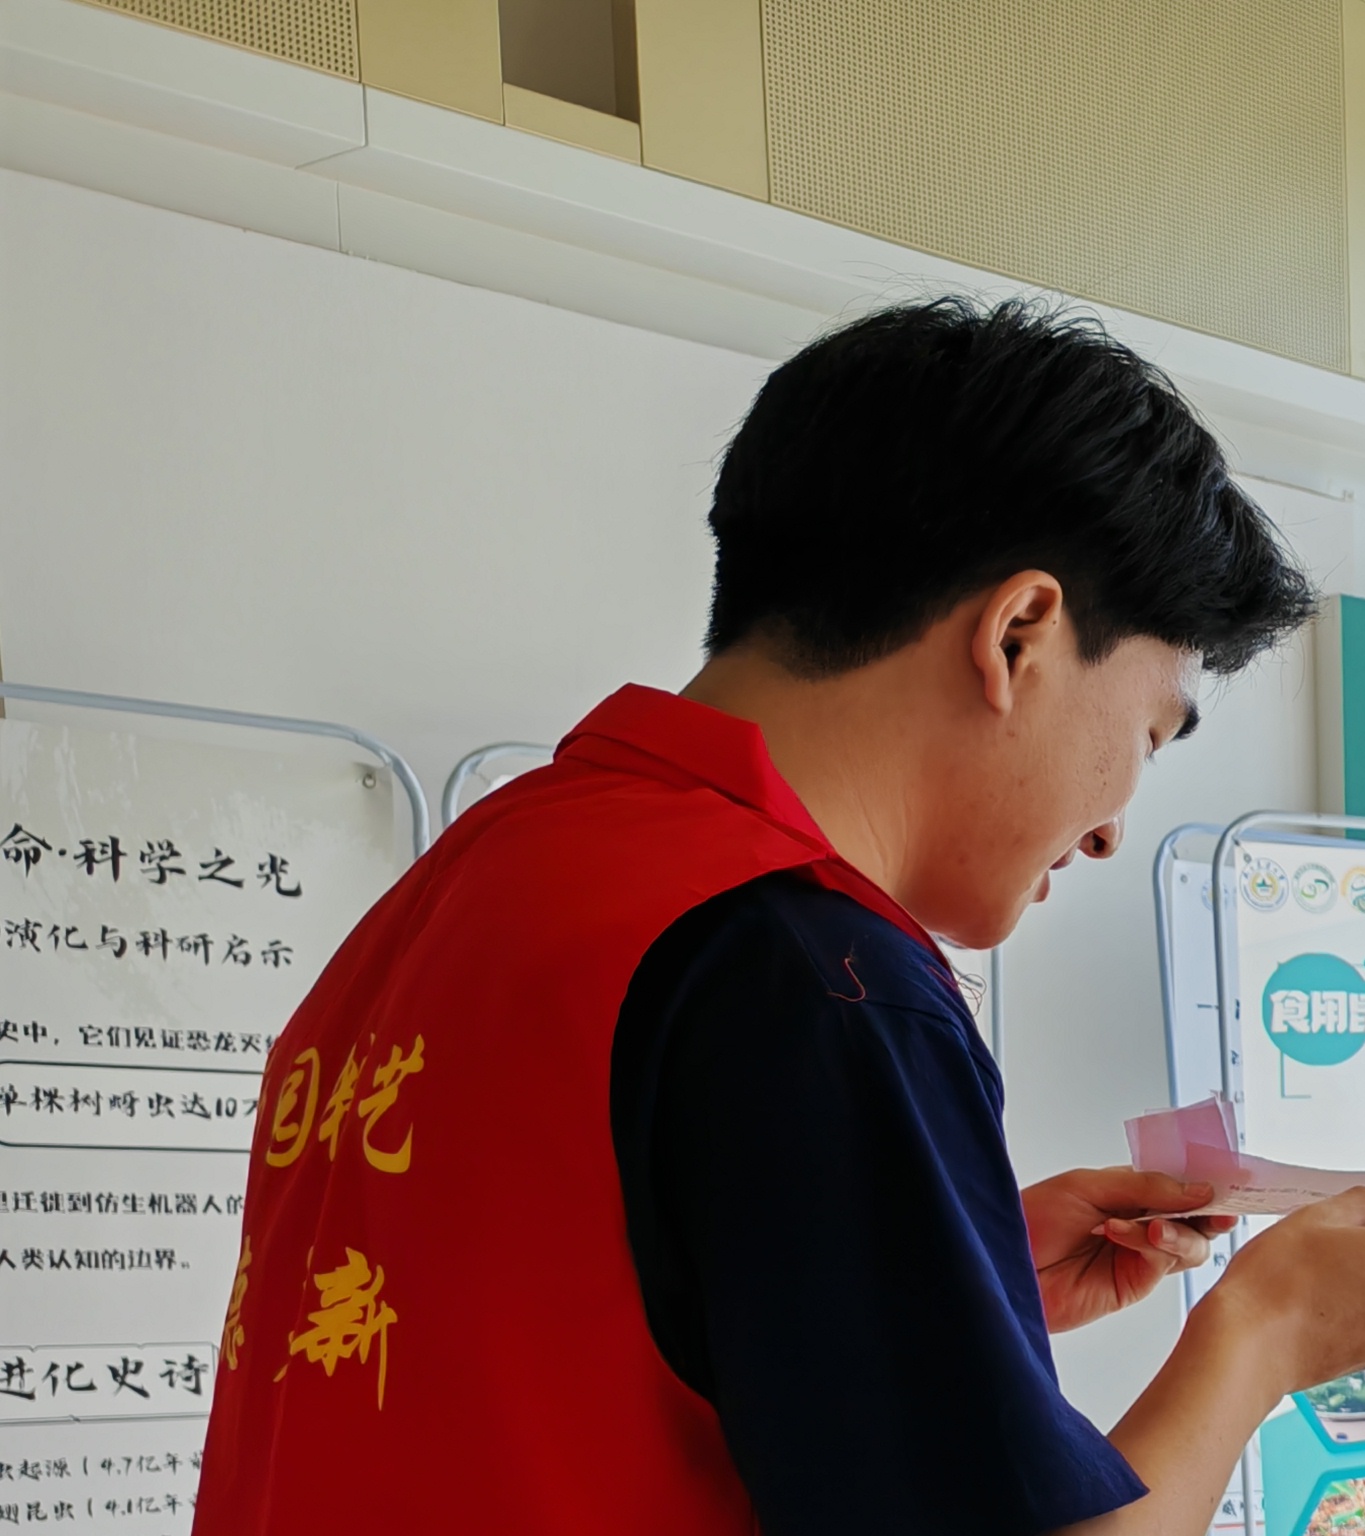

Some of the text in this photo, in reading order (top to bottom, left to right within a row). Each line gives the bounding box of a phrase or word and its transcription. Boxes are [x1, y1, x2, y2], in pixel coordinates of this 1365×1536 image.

[4, 918, 295, 969] 演化与科研启示
